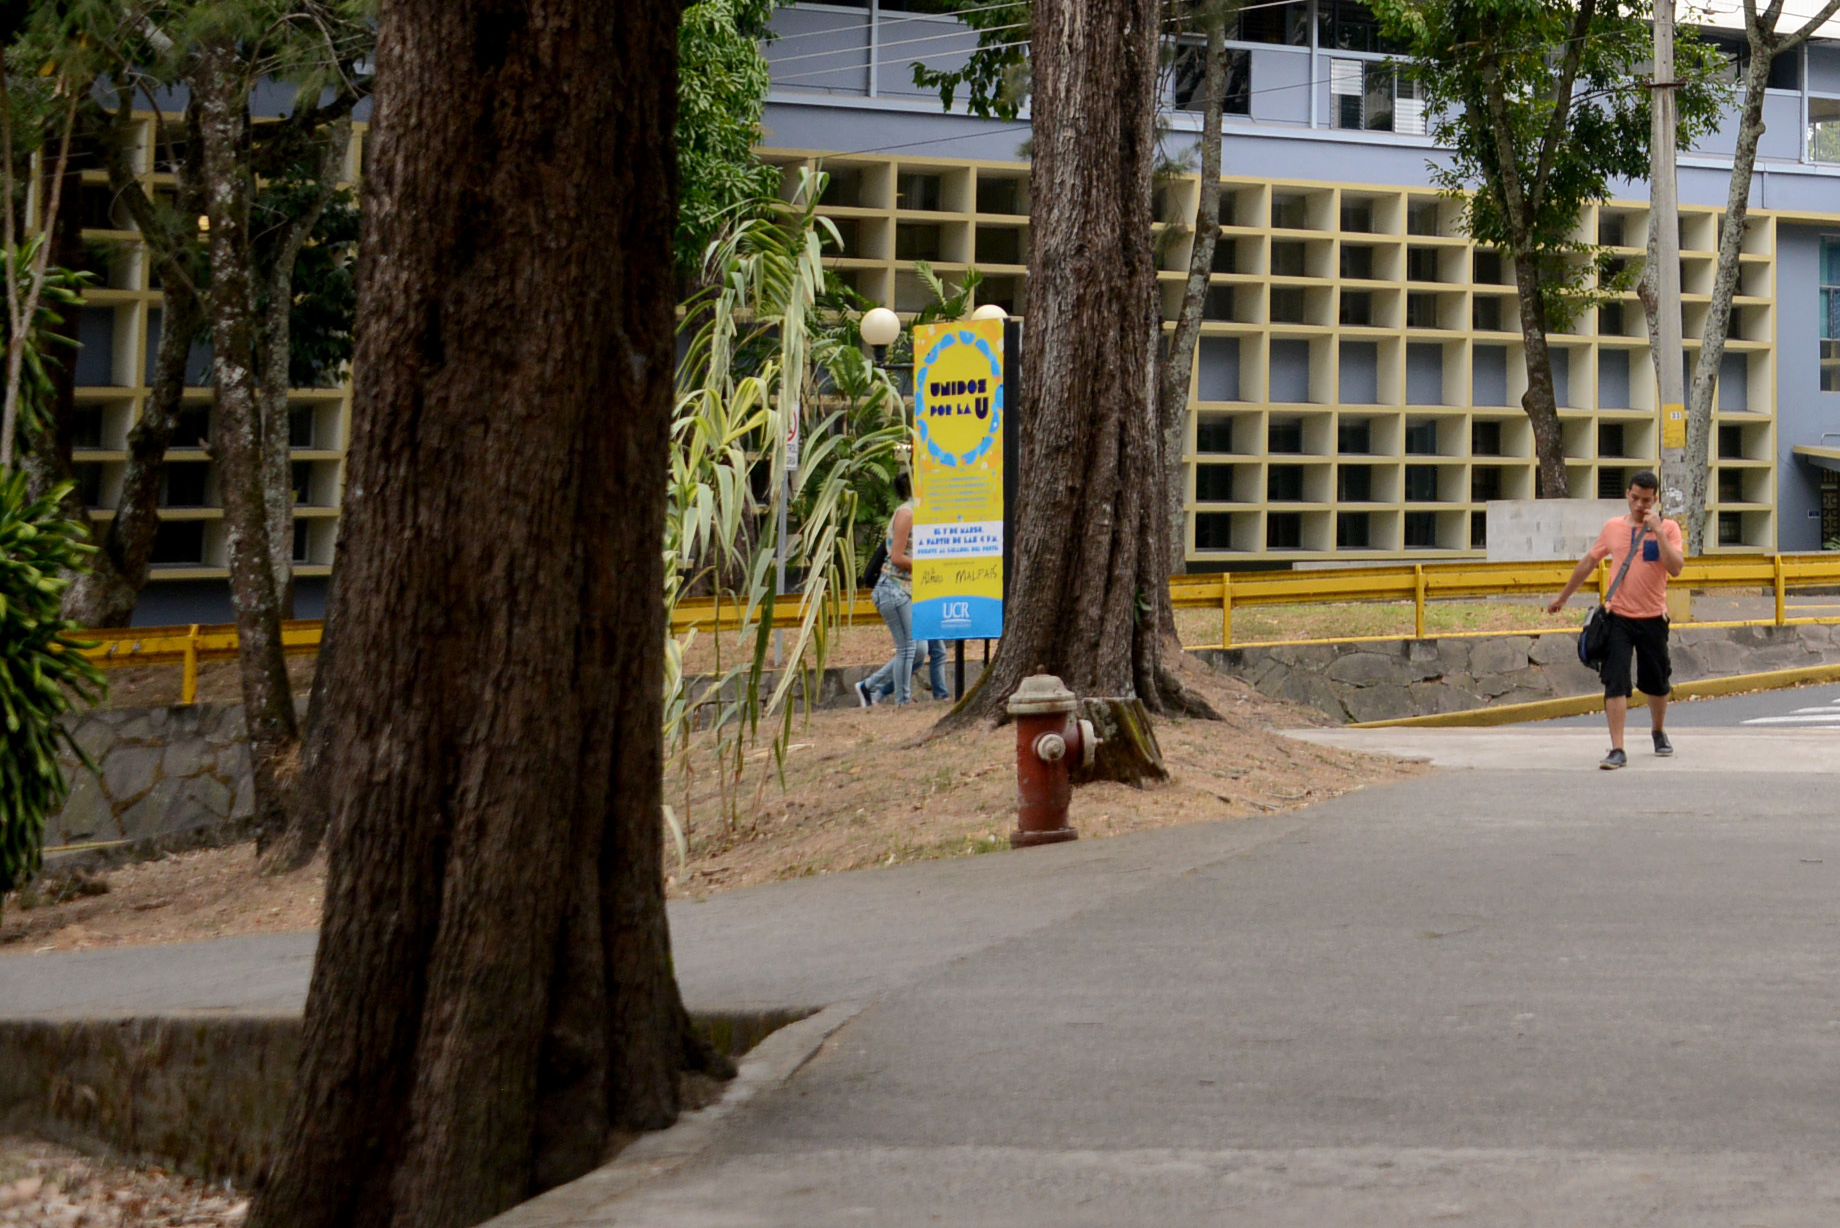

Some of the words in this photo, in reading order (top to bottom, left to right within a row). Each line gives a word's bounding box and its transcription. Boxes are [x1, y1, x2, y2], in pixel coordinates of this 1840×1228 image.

[931, 379, 986, 397] UNIDOS
[931, 404, 951, 417] POR
[957, 403, 971, 415] LA
[975, 397, 988, 419] U
[952, 536, 961, 544] DE
[963, 535, 977, 543] LAS
[943, 601, 971, 619] UCR
